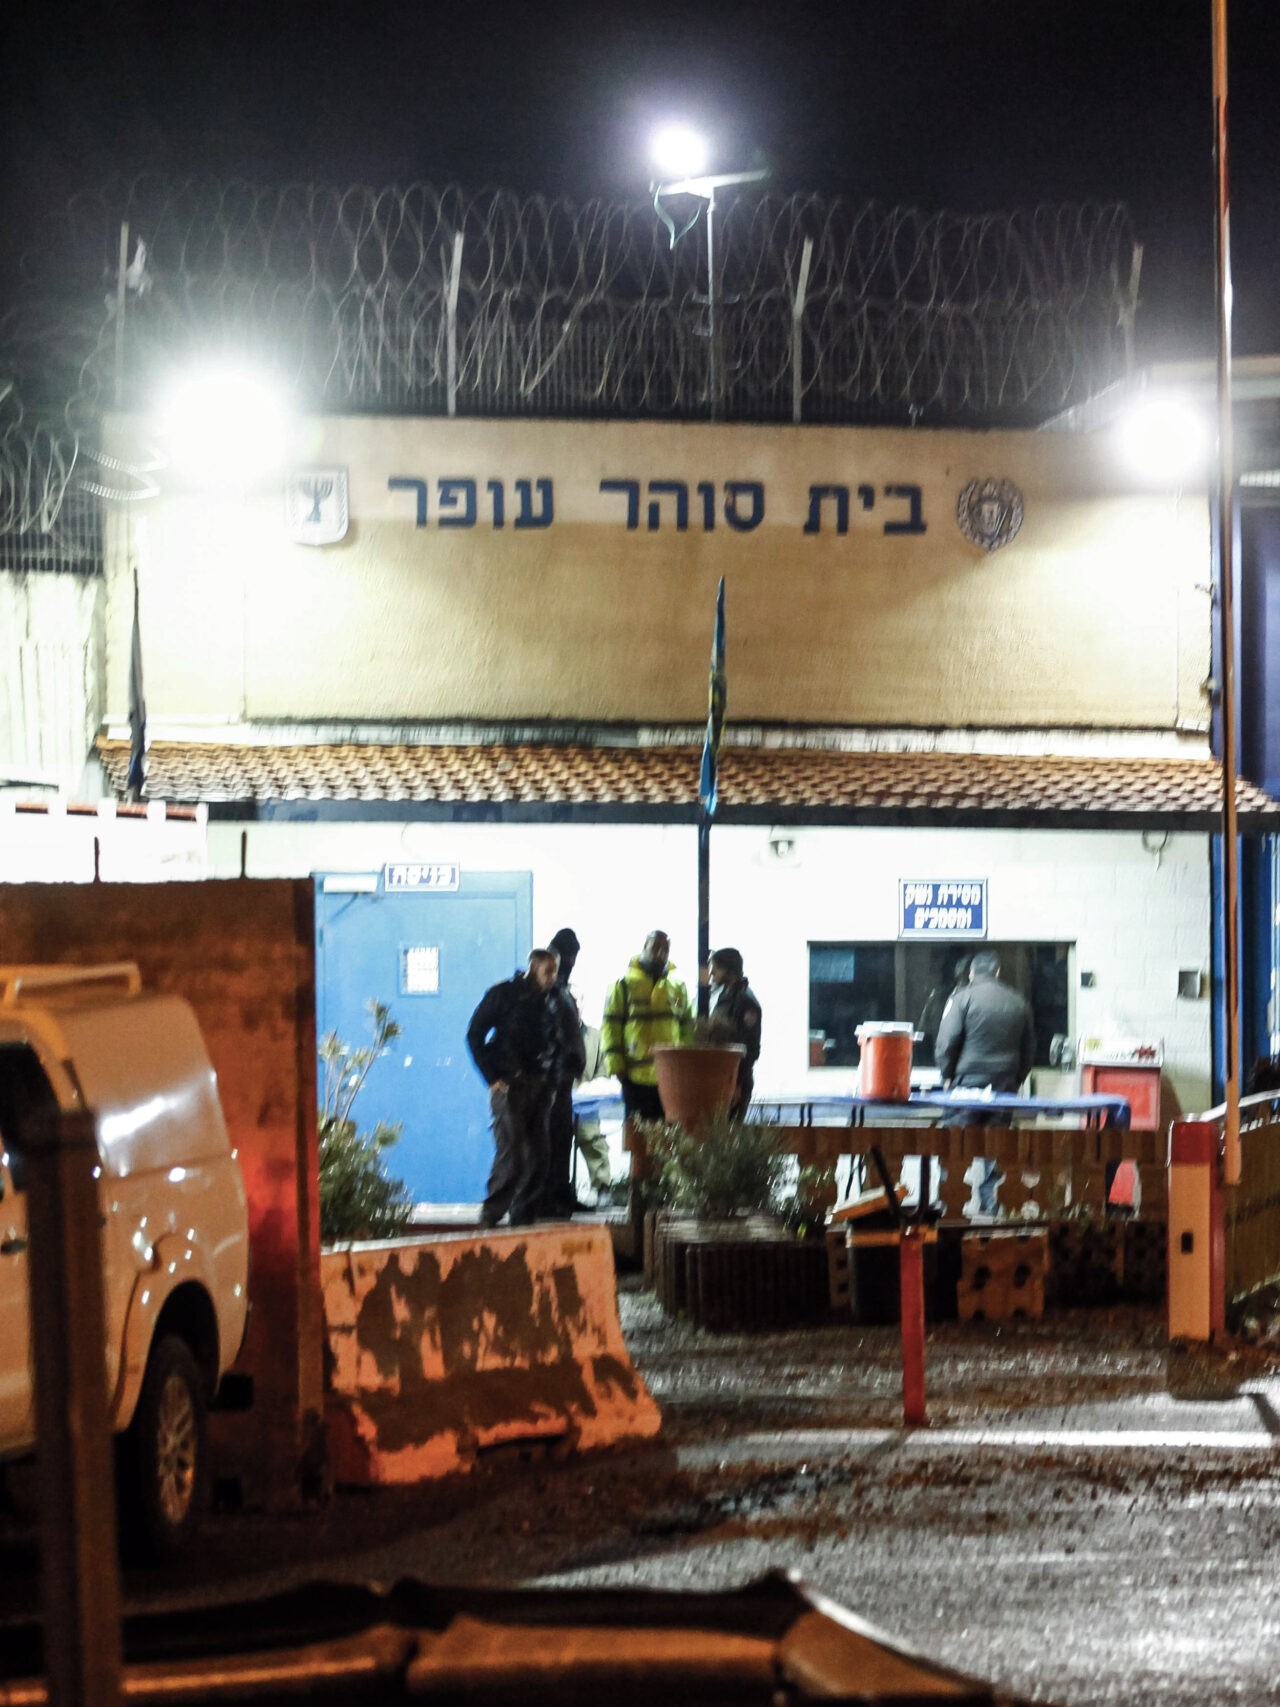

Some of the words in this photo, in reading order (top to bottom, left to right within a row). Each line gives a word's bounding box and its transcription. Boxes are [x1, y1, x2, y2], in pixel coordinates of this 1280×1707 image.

[387, 475, 554, 530] עופר
[599, 479, 765, 533] סוהר
[803, 483, 927, 535] בית
[392, 865, 452, 886] כניסה
[936, 883, 981, 906] מסירת
[905, 883, 933, 910] נשק
